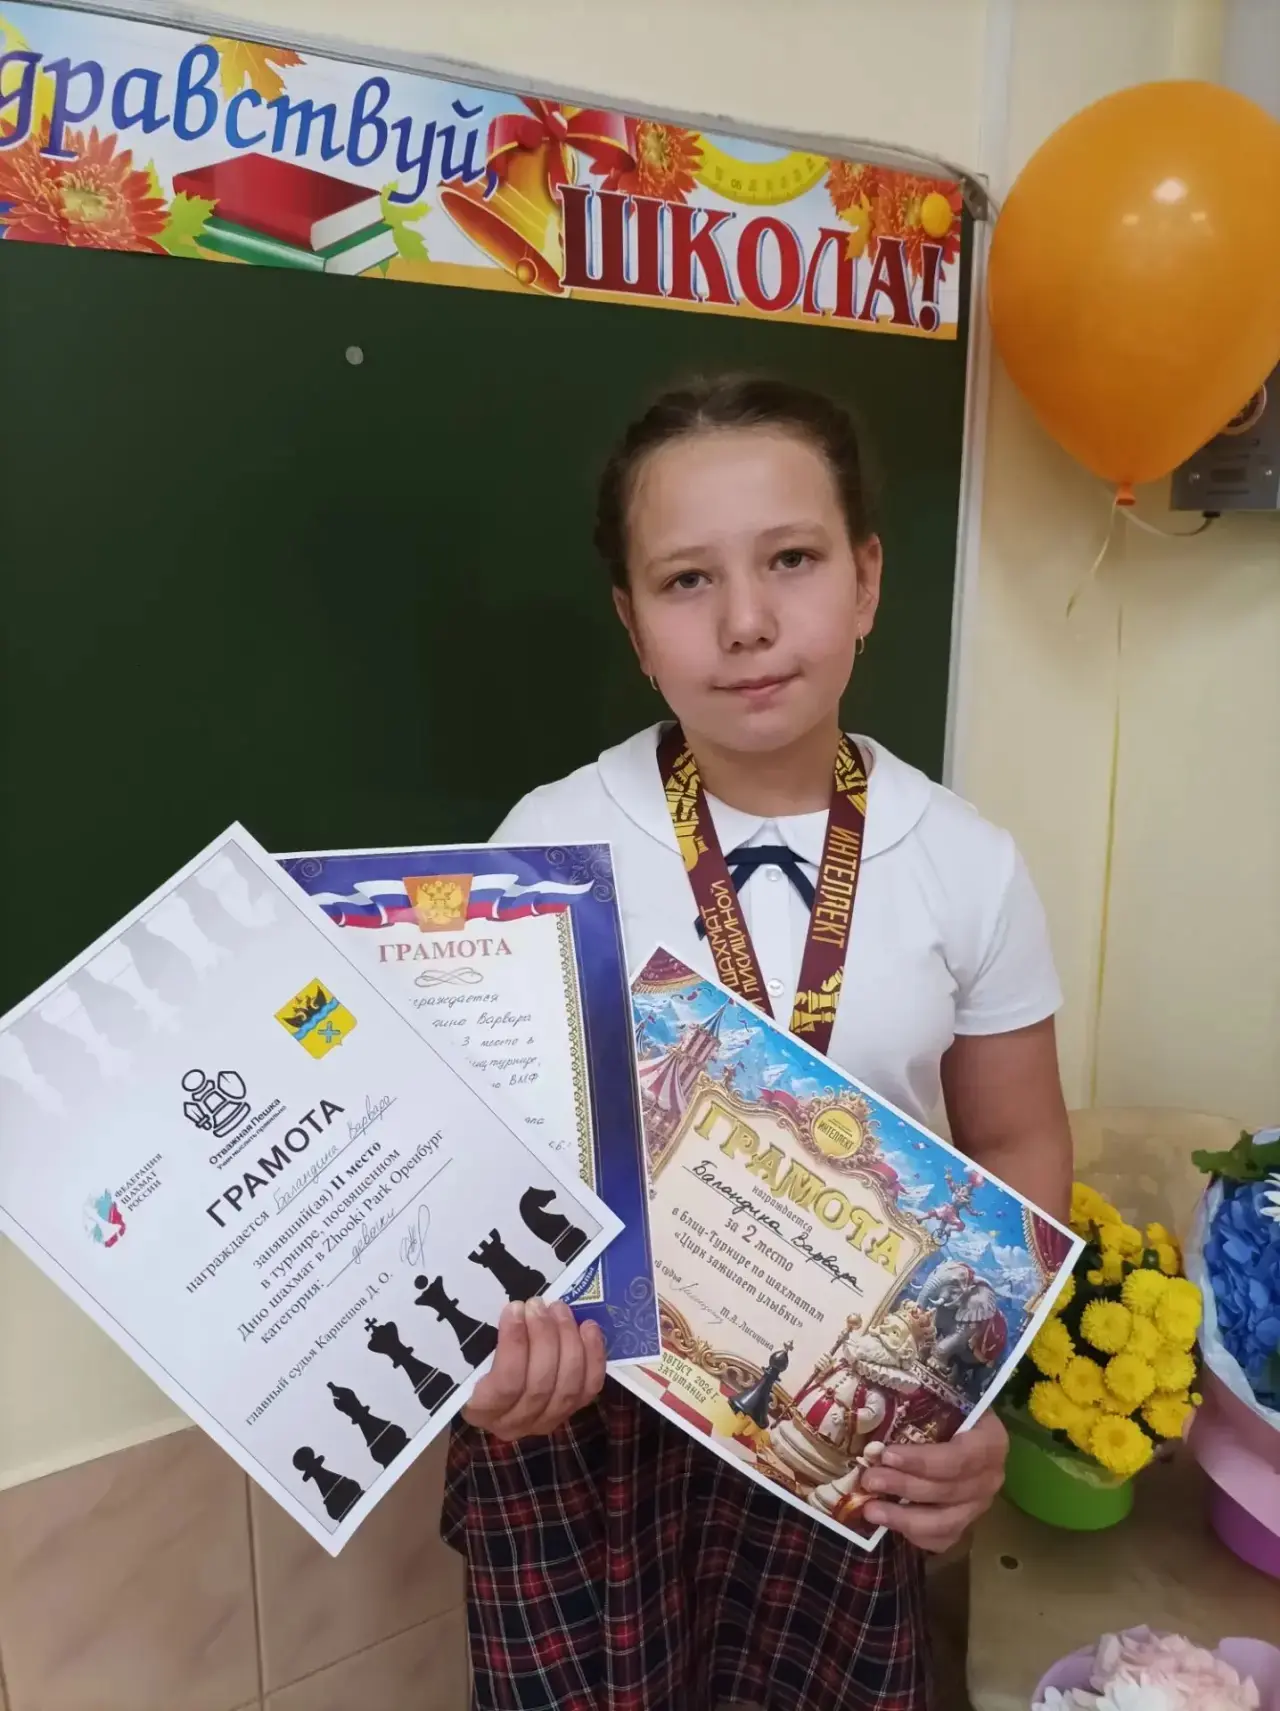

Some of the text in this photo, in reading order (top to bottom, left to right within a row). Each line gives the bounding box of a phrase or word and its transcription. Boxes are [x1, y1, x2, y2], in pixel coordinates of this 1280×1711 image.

[557, 185, 943, 333] ШКОЛА!
[812, 825, 861, 949] ИНТЕЛЛЕКТ
[378, 937, 514, 963] ГРАМОТА
[700, 905, 740, 987] ШАХМАТ
[710, 879, 760, 992] ЛИСИЦИНОЙ
[461, 1036, 470, 1047] 3
[206, 1099, 345, 1228] ГРАМОТА
[209, 1098, 281, 1165] Отважная Пешка
[114, 1153, 163, 1198] ФЕДЕРАЦИЯ
[120, 1171, 158, 1205] ШАХМАТ
[127, 1179, 162, 1212] РОССИИ
[253, 1141, 382, 1270] занявший(ая) II место
[694, 1100, 904, 1277] ГРАМОТА
[752, 1185, 813, 1233] награждается
[186, 1210, 270, 1294] награждается
[237, 1308, 269, 1342] Дню
[268, 1260, 316, 1309] шахмат
[314, 1252, 325, 1263] в
[322, 1208, 366, 1253] Zhooki
[361, 1182, 393, 1212] Park
[390, 1129, 443, 1184] Оренбург
[260, 1149, 401, 1290] в турнире, посвященном
[724, 1217, 794, 1272] за 2 место
[661, 1266, 682, 1283] судья
[671, 1207, 680, 1216] в
[751, 1263, 765, 1279] по
[765, 1274, 825, 1322] шахматам
[674, 1231, 708, 1259] «Цирк
[706, 1255, 757, 1296] зажигает
[755, 1290, 804, 1328] улыбки»
[791, 1231, 864, 1293] Варвара
[261, 1279, 324, 1344] категория:
[245, 1375, 289, 1426] главный
[288, 1349, 317, 1379] судья
